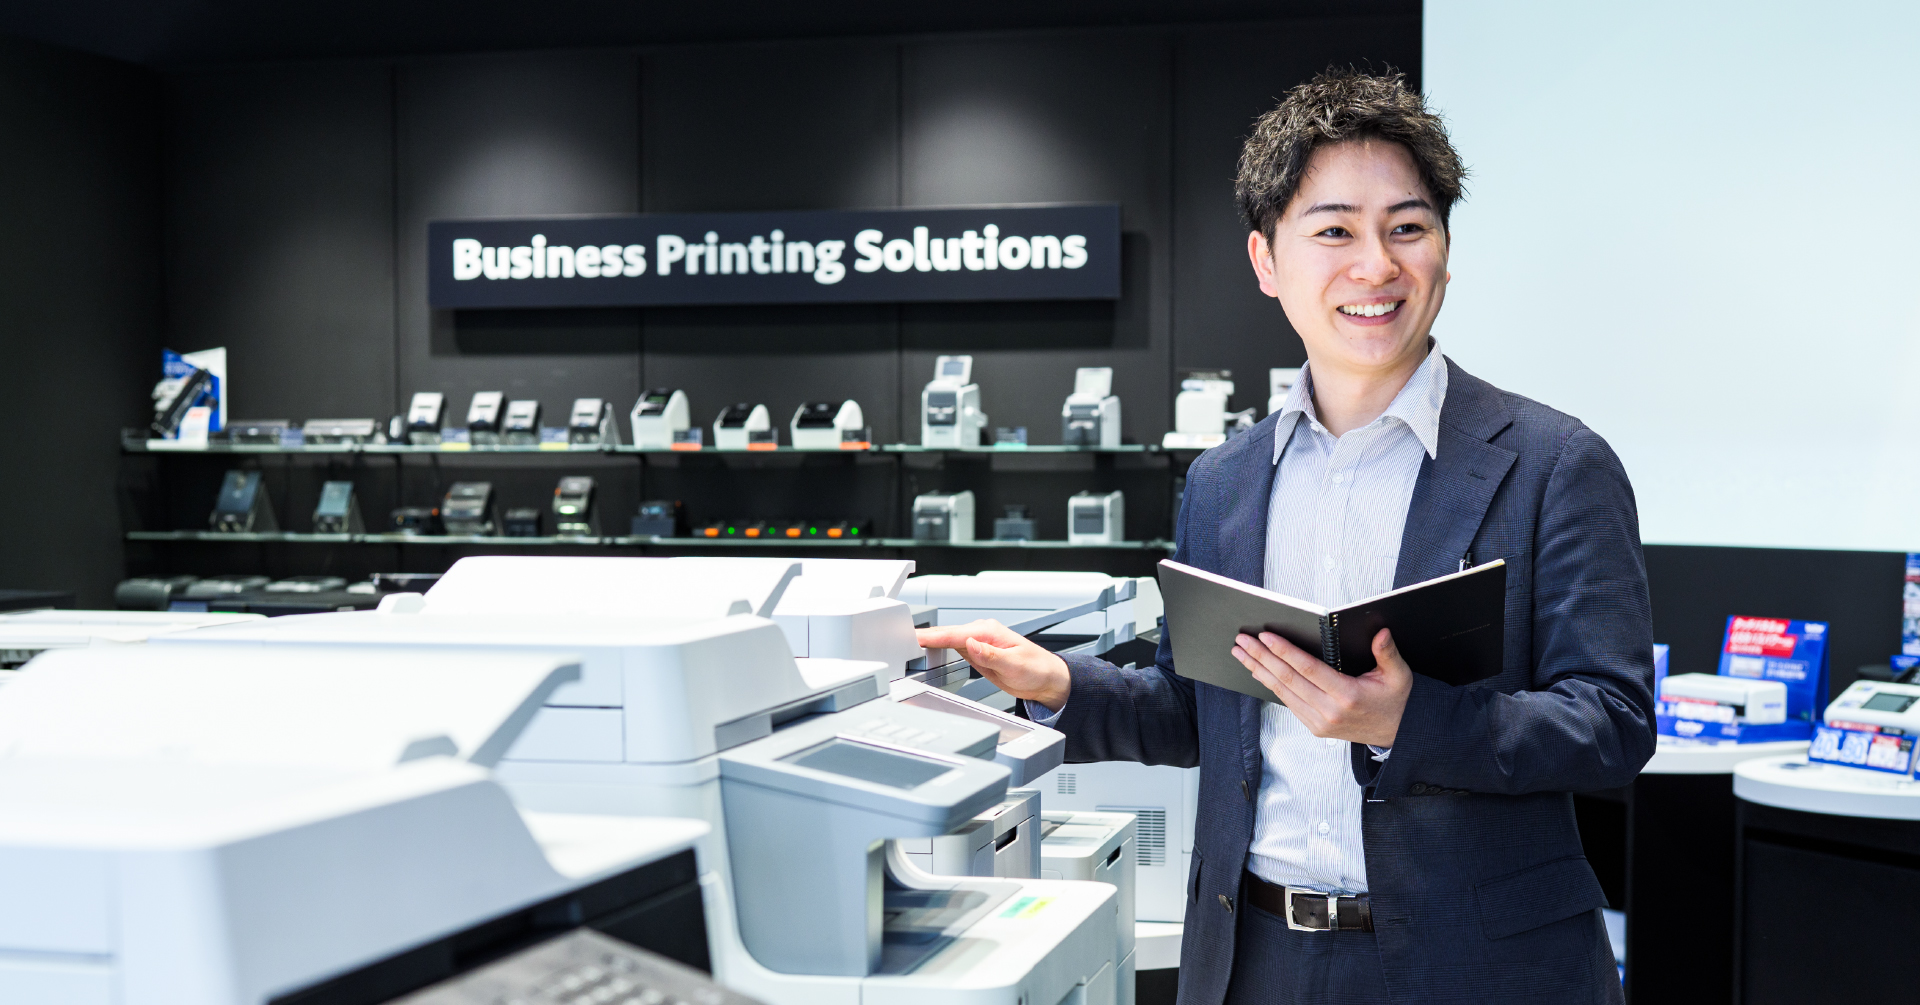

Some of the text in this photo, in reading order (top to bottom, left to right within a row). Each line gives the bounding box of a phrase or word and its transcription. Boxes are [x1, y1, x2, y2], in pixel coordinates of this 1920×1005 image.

[452, 223, 1089, 285] Business Printing Solutions
